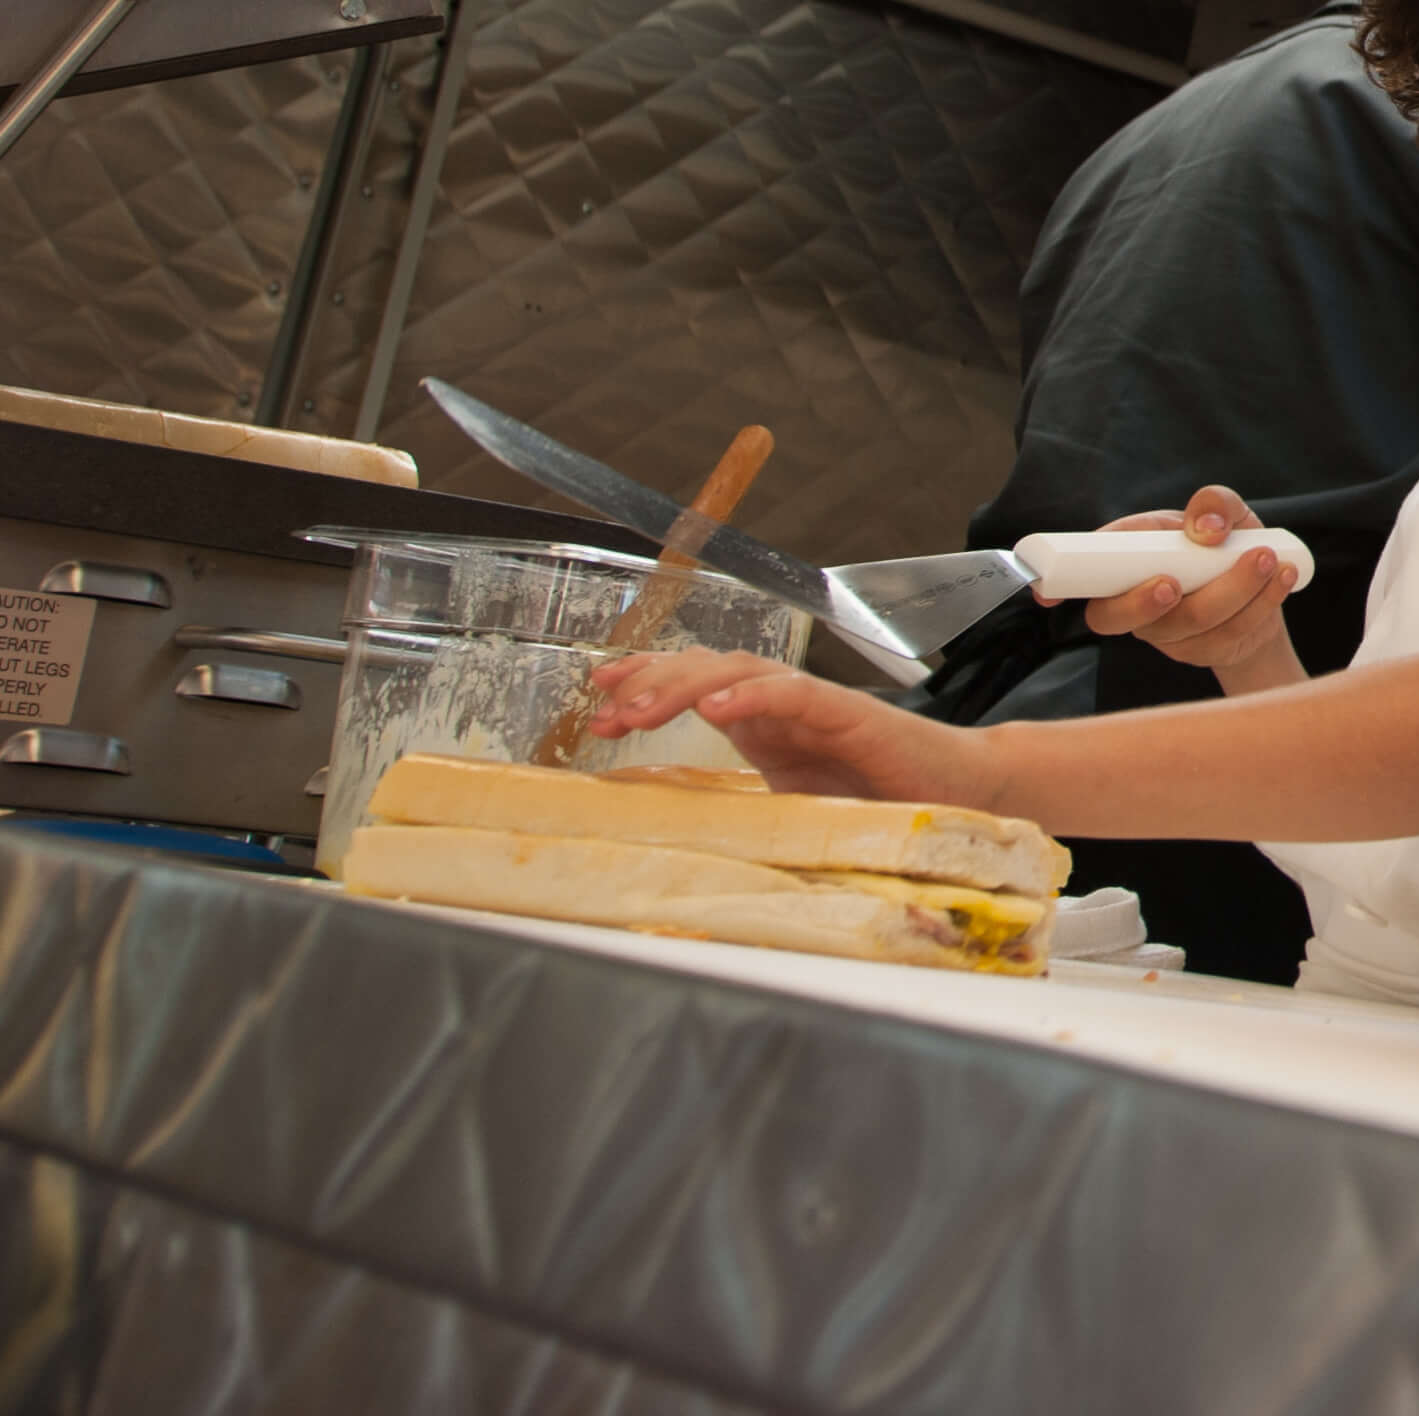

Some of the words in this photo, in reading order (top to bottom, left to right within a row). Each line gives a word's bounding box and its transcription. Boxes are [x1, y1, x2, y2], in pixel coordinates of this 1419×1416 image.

[0, 593, 60, 614] UTION:
[12, 616, 51, 633] NOT
[24, 660, 70, 678] LEGS
